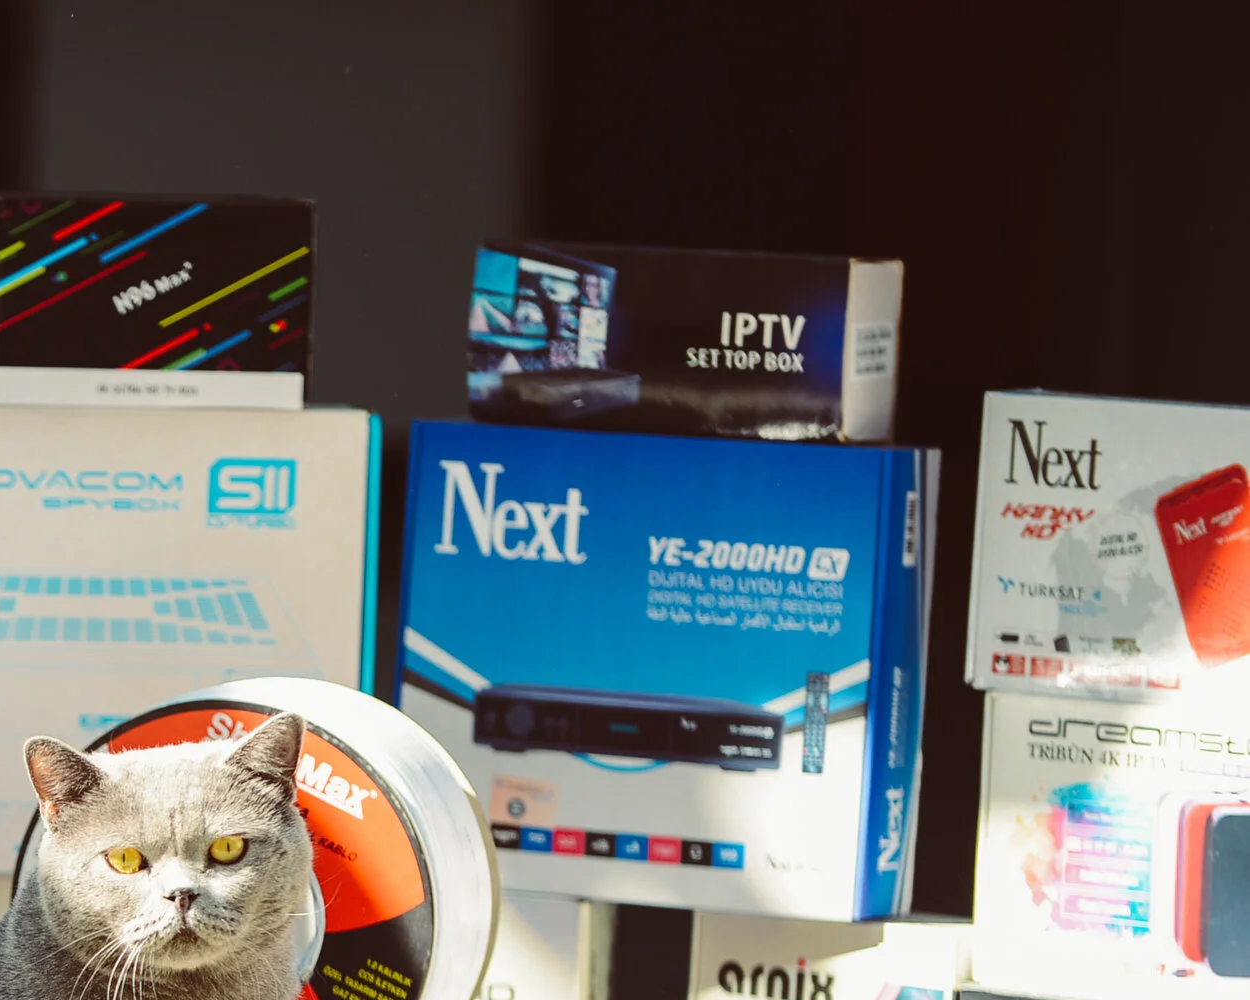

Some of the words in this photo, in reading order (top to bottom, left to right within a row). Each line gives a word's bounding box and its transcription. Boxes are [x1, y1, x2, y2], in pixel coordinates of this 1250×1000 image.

[720, 311, 806, 350] IPTV
[686, 347, 721, 369] SET
[723, 349, 762, 370] TOP
[764, 351, 805, 373] BOX
[1003, 419, 1103, 492] Next
[42, 496, 181, 511] SPYBOX
[433, 459, 590, 566] Next
[1173, 516, 1209, 546] Next
[648, 535, 807, 575] YE-2000HD
[710, 573, 735, 593] HD
[737, 575, 784, 597] UYDU
[1029, 717, 1250, 756] dreamst
[317, 835, 358, 862] KABLO
[876, 785, 904, 876] Next
